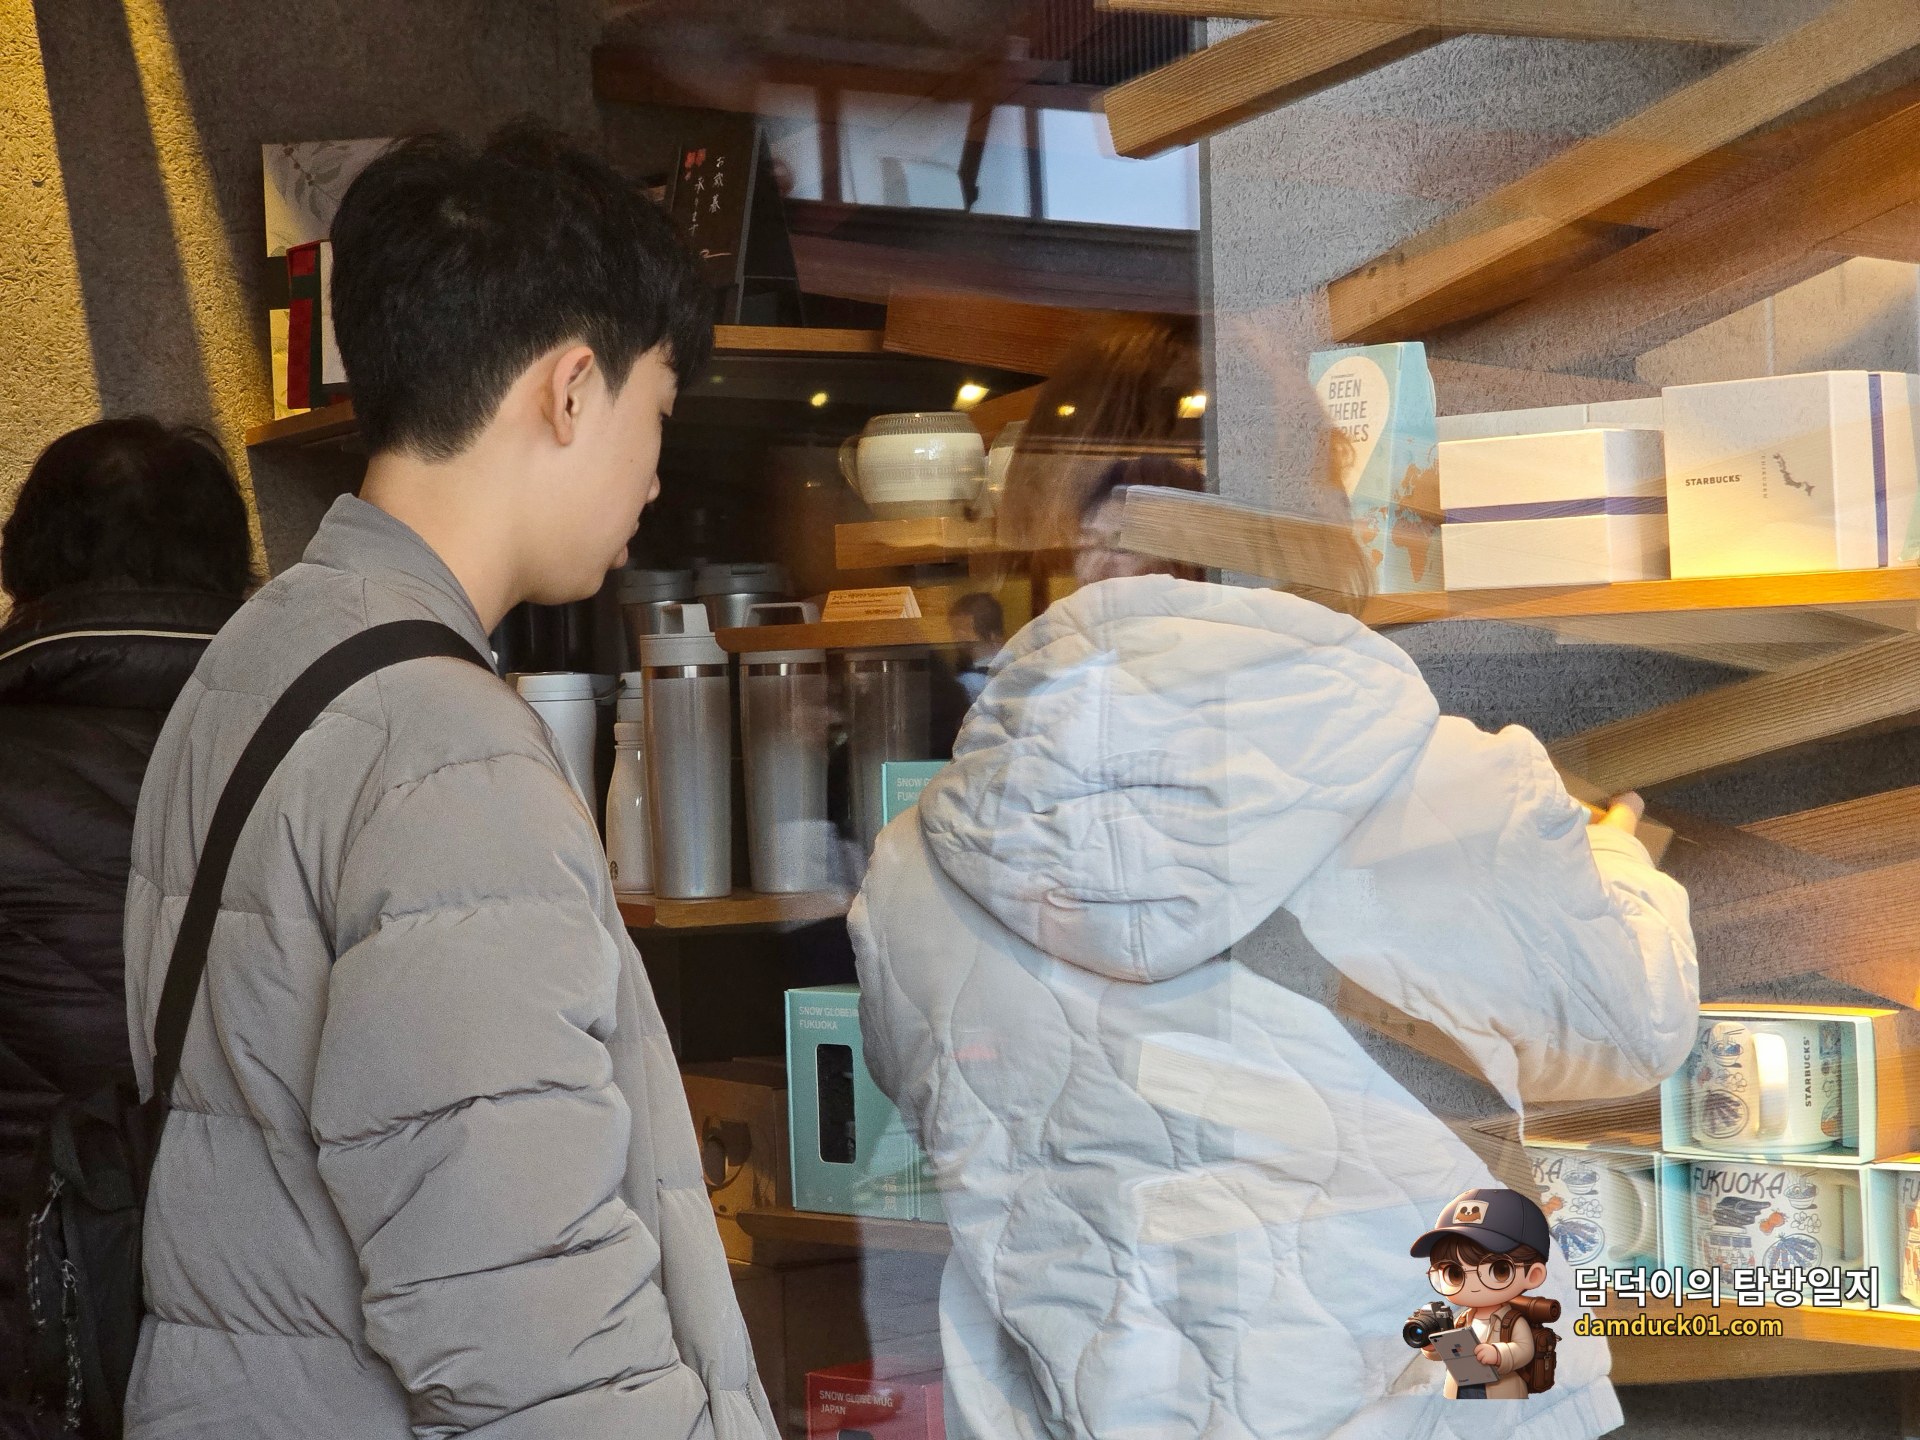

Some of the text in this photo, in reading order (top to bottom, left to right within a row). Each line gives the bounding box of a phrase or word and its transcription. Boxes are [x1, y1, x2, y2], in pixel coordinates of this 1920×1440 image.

[1329, 379, 1361, 400] BEEN
[1328, 401, 1368, 421] THERE
[1685, 474, 1742, 486] STARBUCKS
[799, 1006, 823, 1016] SNOW
[799, 1019, 838, 1030] FUKUOKA
[1803, 1037, 1812, 1107] STARBUCKS
[1694, 1167, 1785, 1199] FUKUOKA
[819, 1390, 844, 1401] SNOW
[873, 1395, 893, 1407] MUG
[821, 1404, 846, 1415] JAPAN
